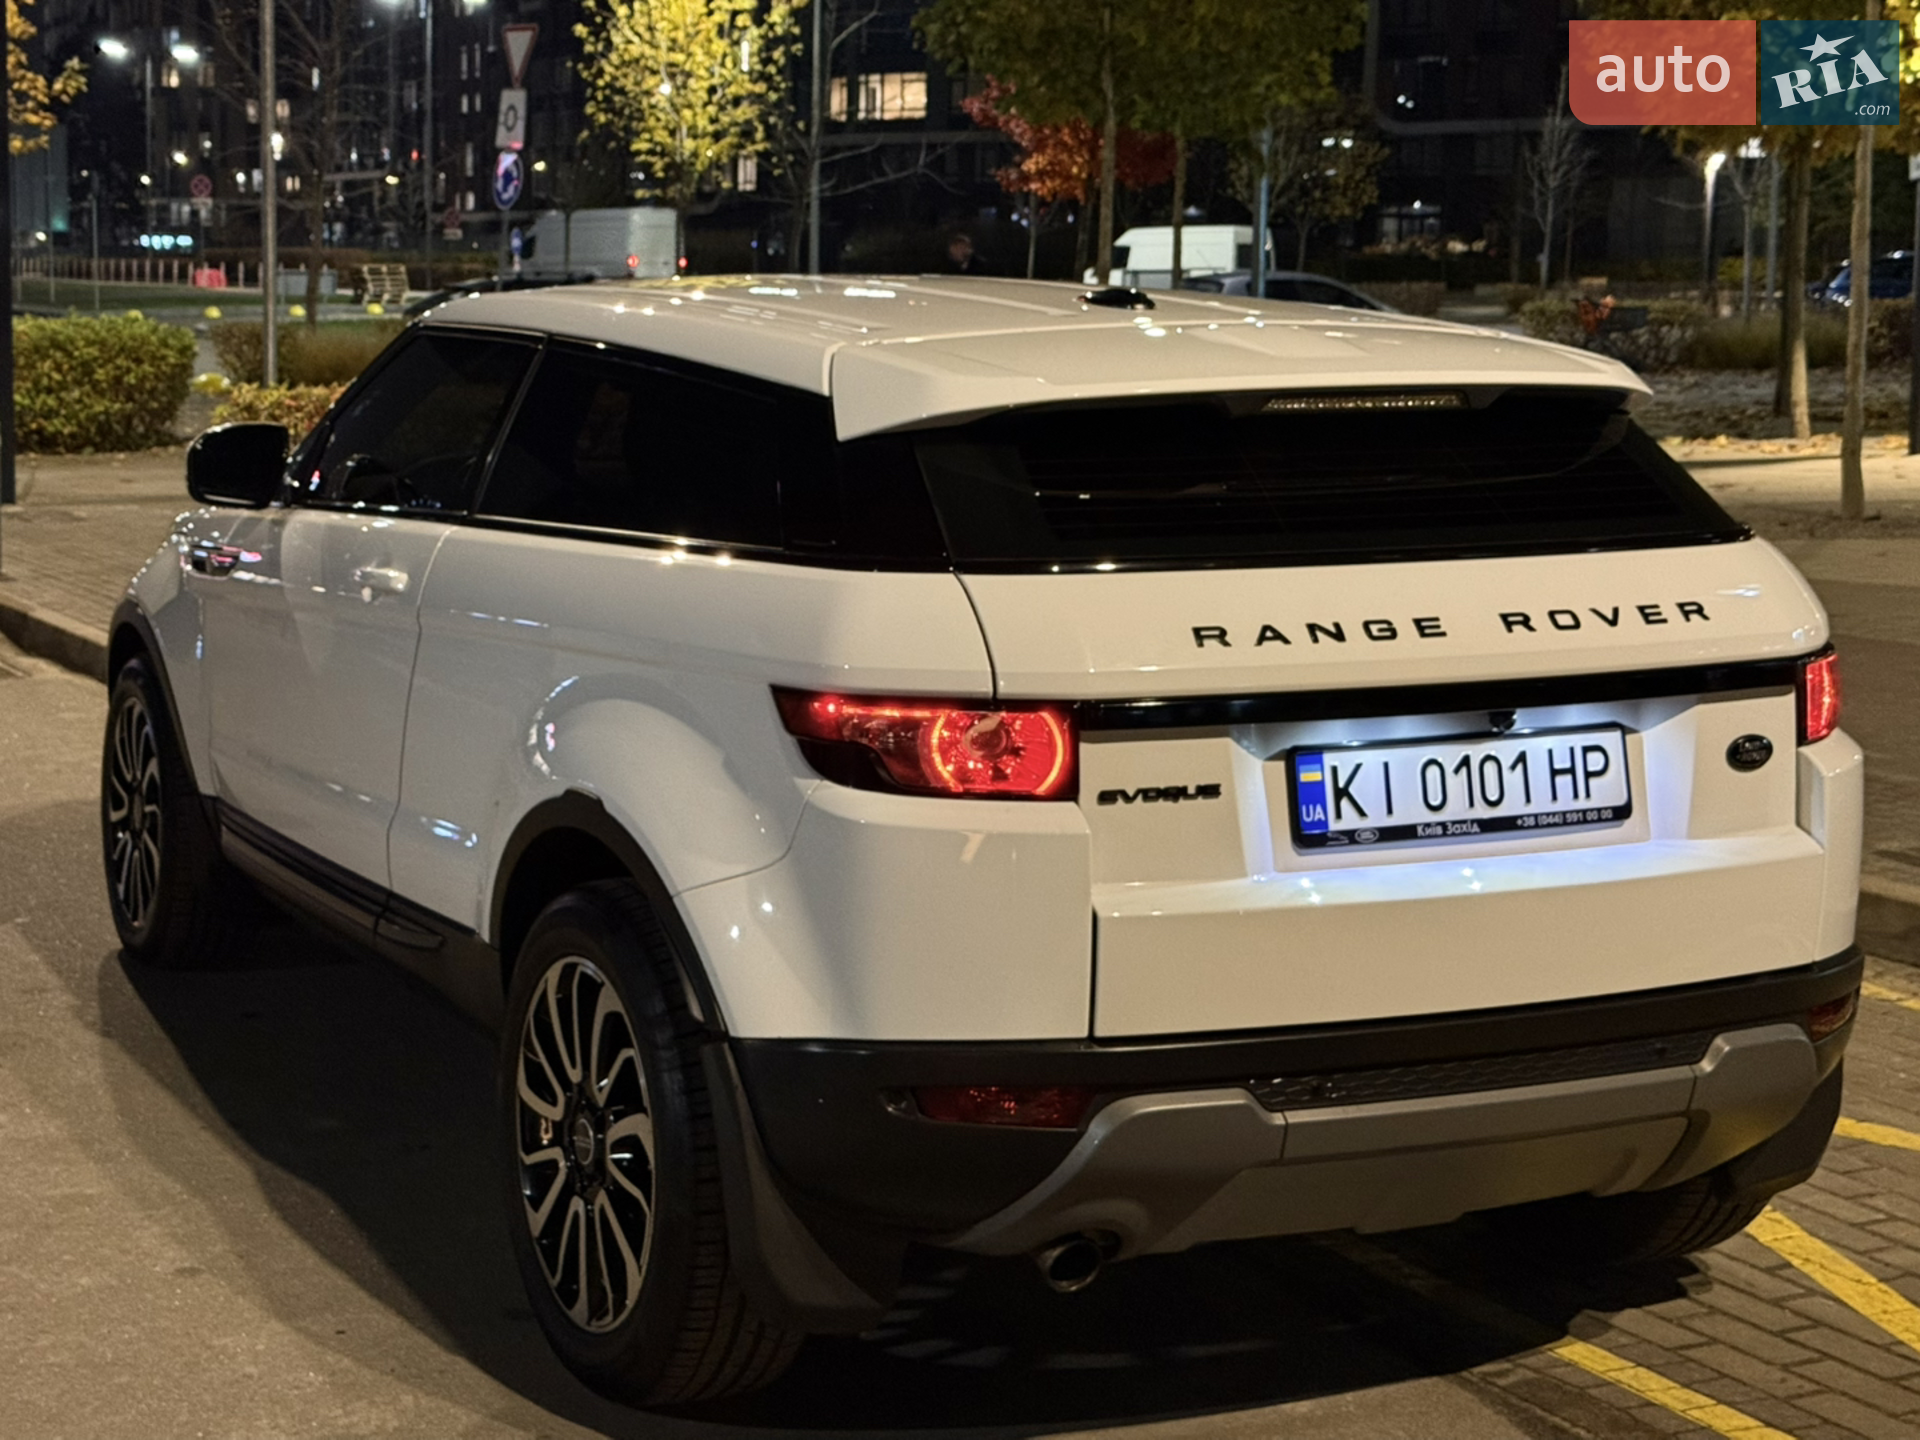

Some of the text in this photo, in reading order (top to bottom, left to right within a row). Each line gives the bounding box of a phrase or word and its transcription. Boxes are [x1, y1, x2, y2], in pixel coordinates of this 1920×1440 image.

[1192, 600, 1711, 648] RANGE ROVER
[1421, 750, 1532, 813] 0101
[1547, 744, 1610, 802] HP
[1302, 803, 1325, 822] UA
[1516, 815, 1536, 827] +38
